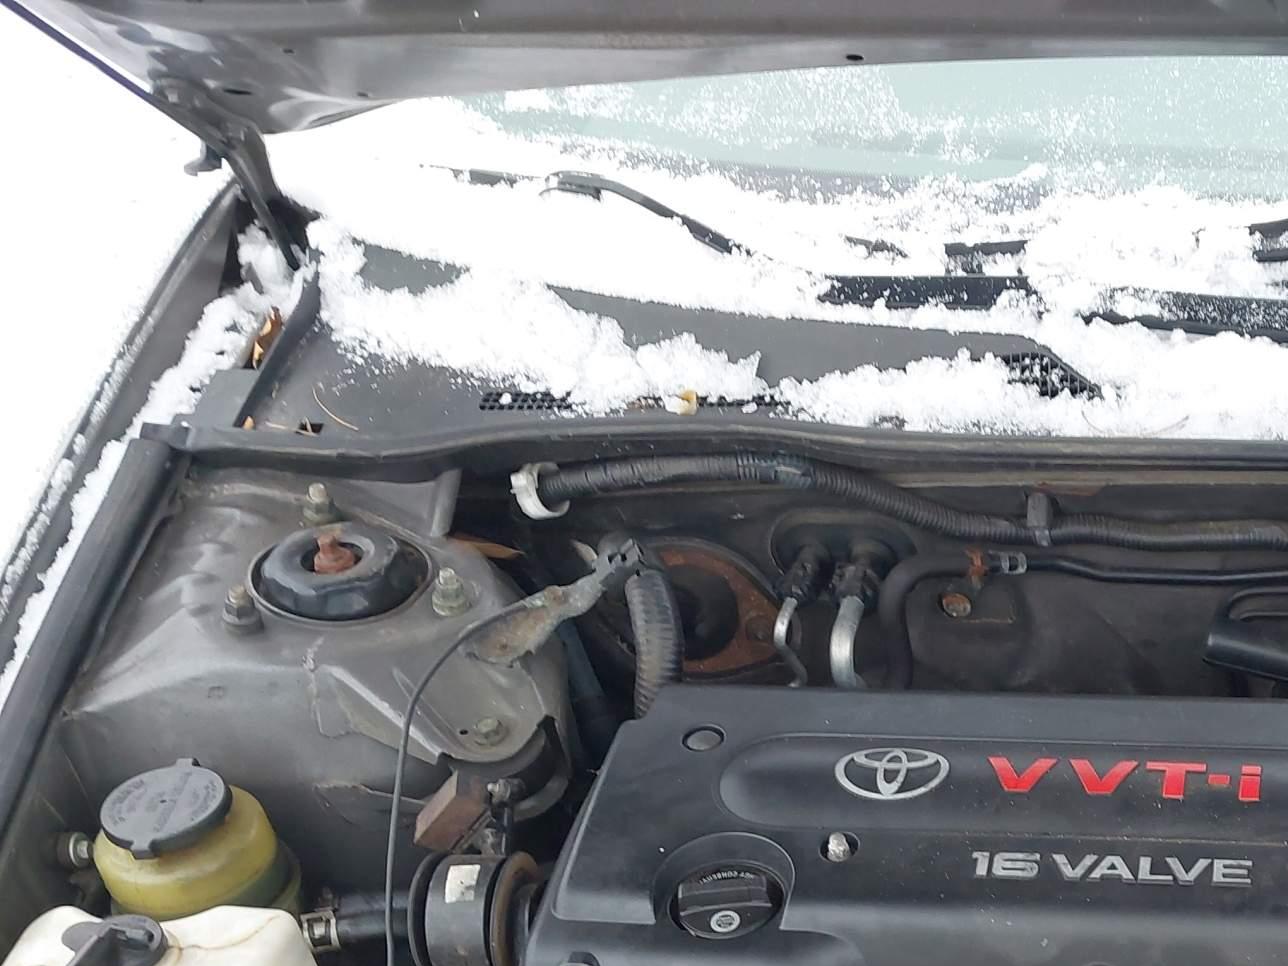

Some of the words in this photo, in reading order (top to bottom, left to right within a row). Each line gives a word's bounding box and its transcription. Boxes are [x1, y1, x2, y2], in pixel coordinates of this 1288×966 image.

[986, 756, 1262, 801] VVT-i
[972, 851, 1041, 878] 16
[1052, 853, 1253, 886] VALVE
